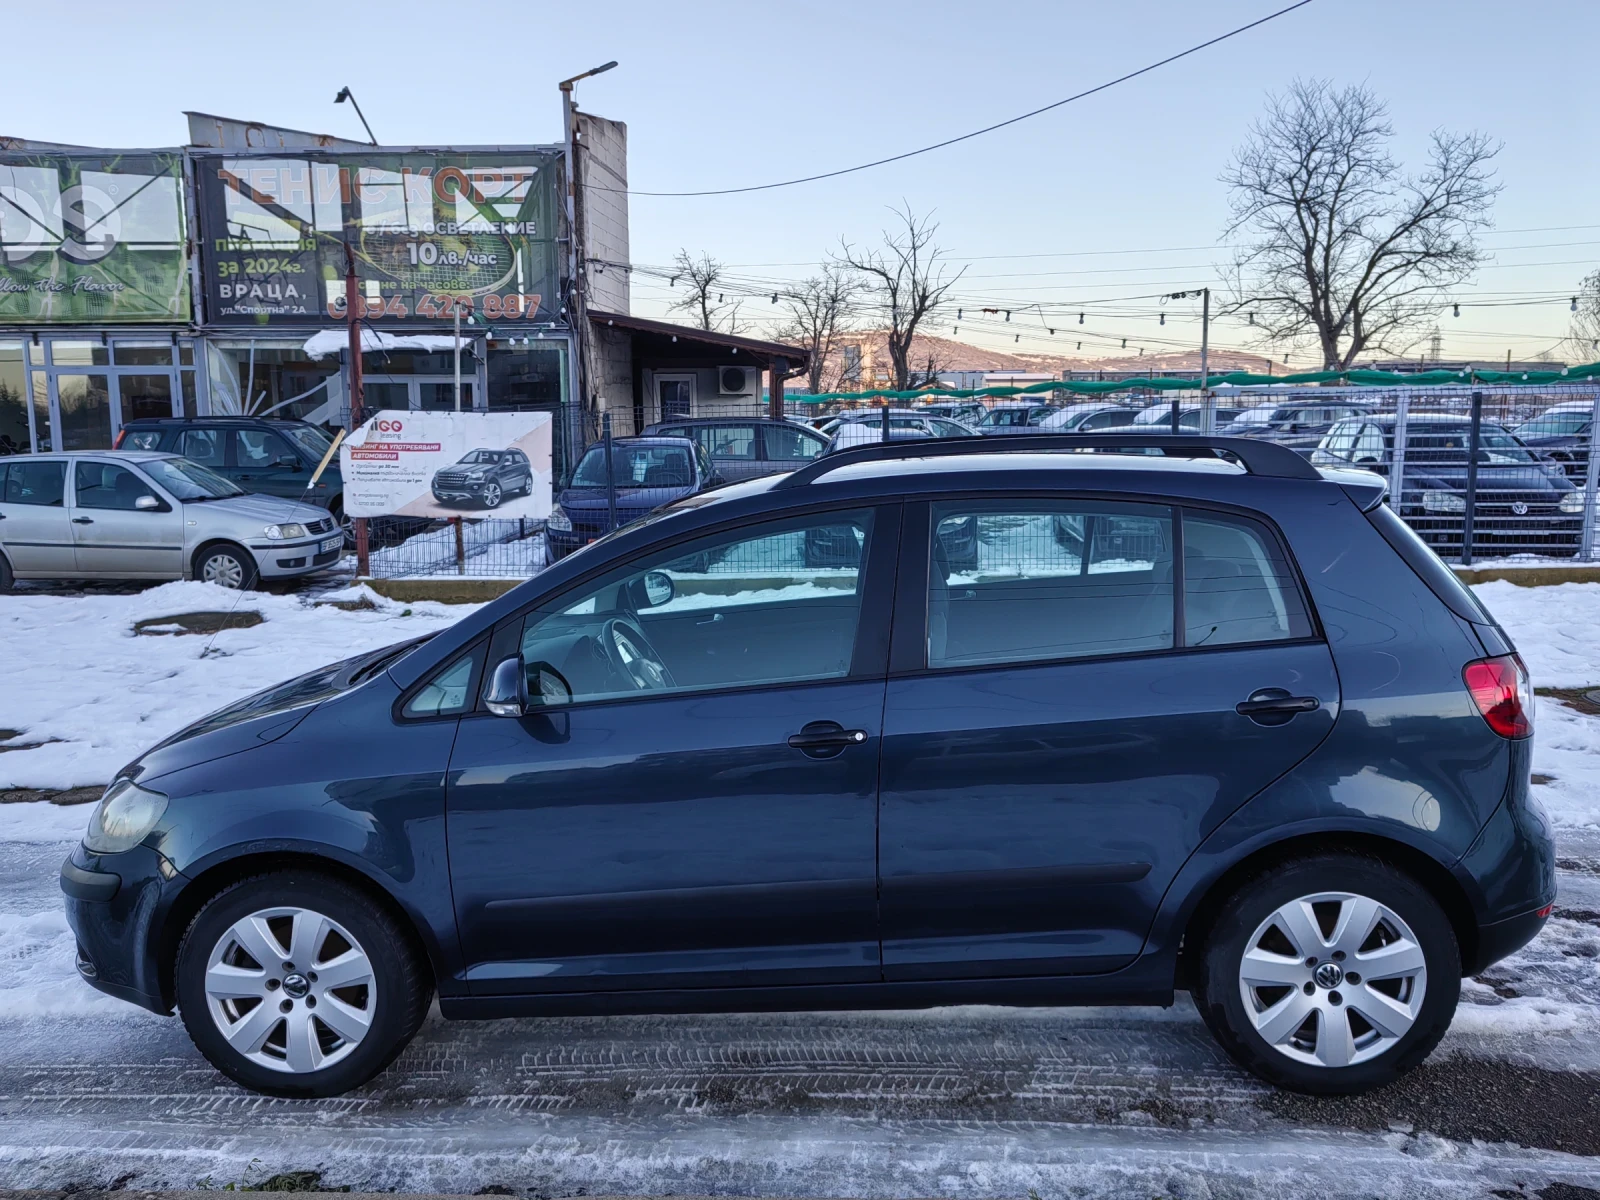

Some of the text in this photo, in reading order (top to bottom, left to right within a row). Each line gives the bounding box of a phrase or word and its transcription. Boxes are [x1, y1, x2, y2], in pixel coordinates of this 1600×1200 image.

[218, 166, 534, 205] ТЕНИС КОРТ
[71, 275, 126, 296] Flavor
[415, 293, 475, 319] 420
[483, 293, 542, 319] 887
